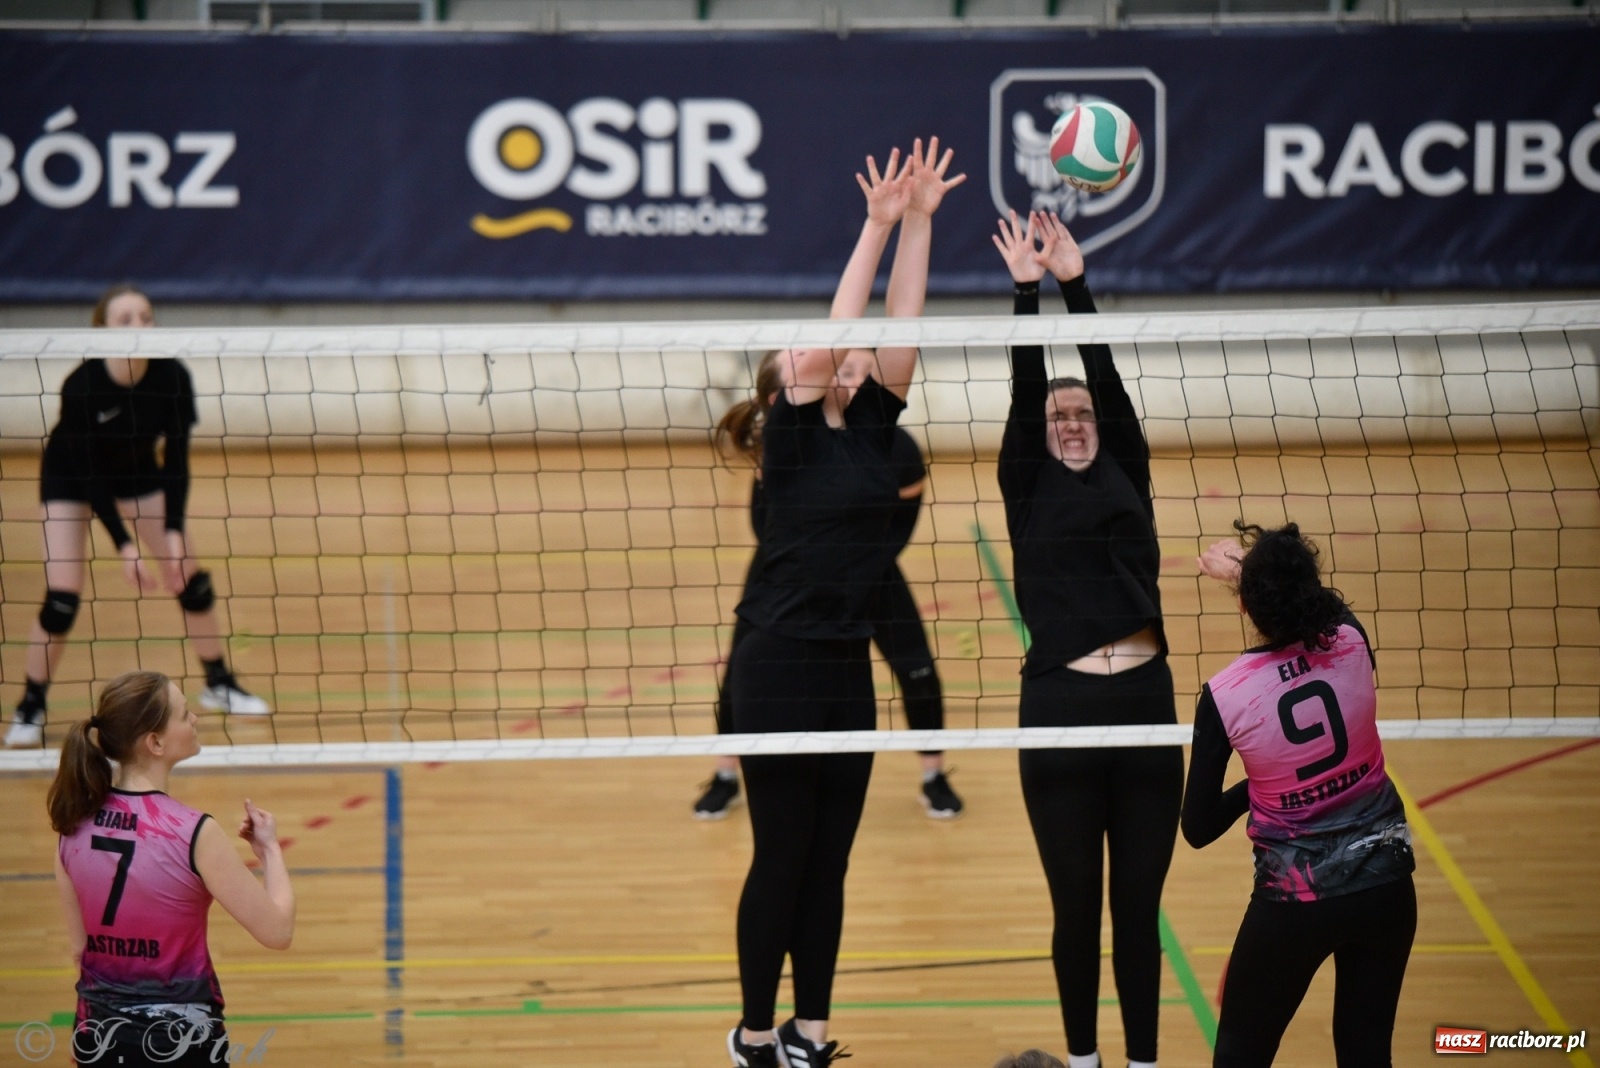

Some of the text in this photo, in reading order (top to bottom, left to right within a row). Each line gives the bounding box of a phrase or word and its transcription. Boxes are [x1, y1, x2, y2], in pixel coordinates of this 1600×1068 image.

[584, 198, 768, 237] RACIBÓRZ
[1277, 656, 1311, 683] ELA
[1277, 680, 1348, 782] 9
[94, 809, 138, 832] BIAŁA
[91, 835, 136, 927] 7
[86, 934, 160, 962] ASTRZĄB
